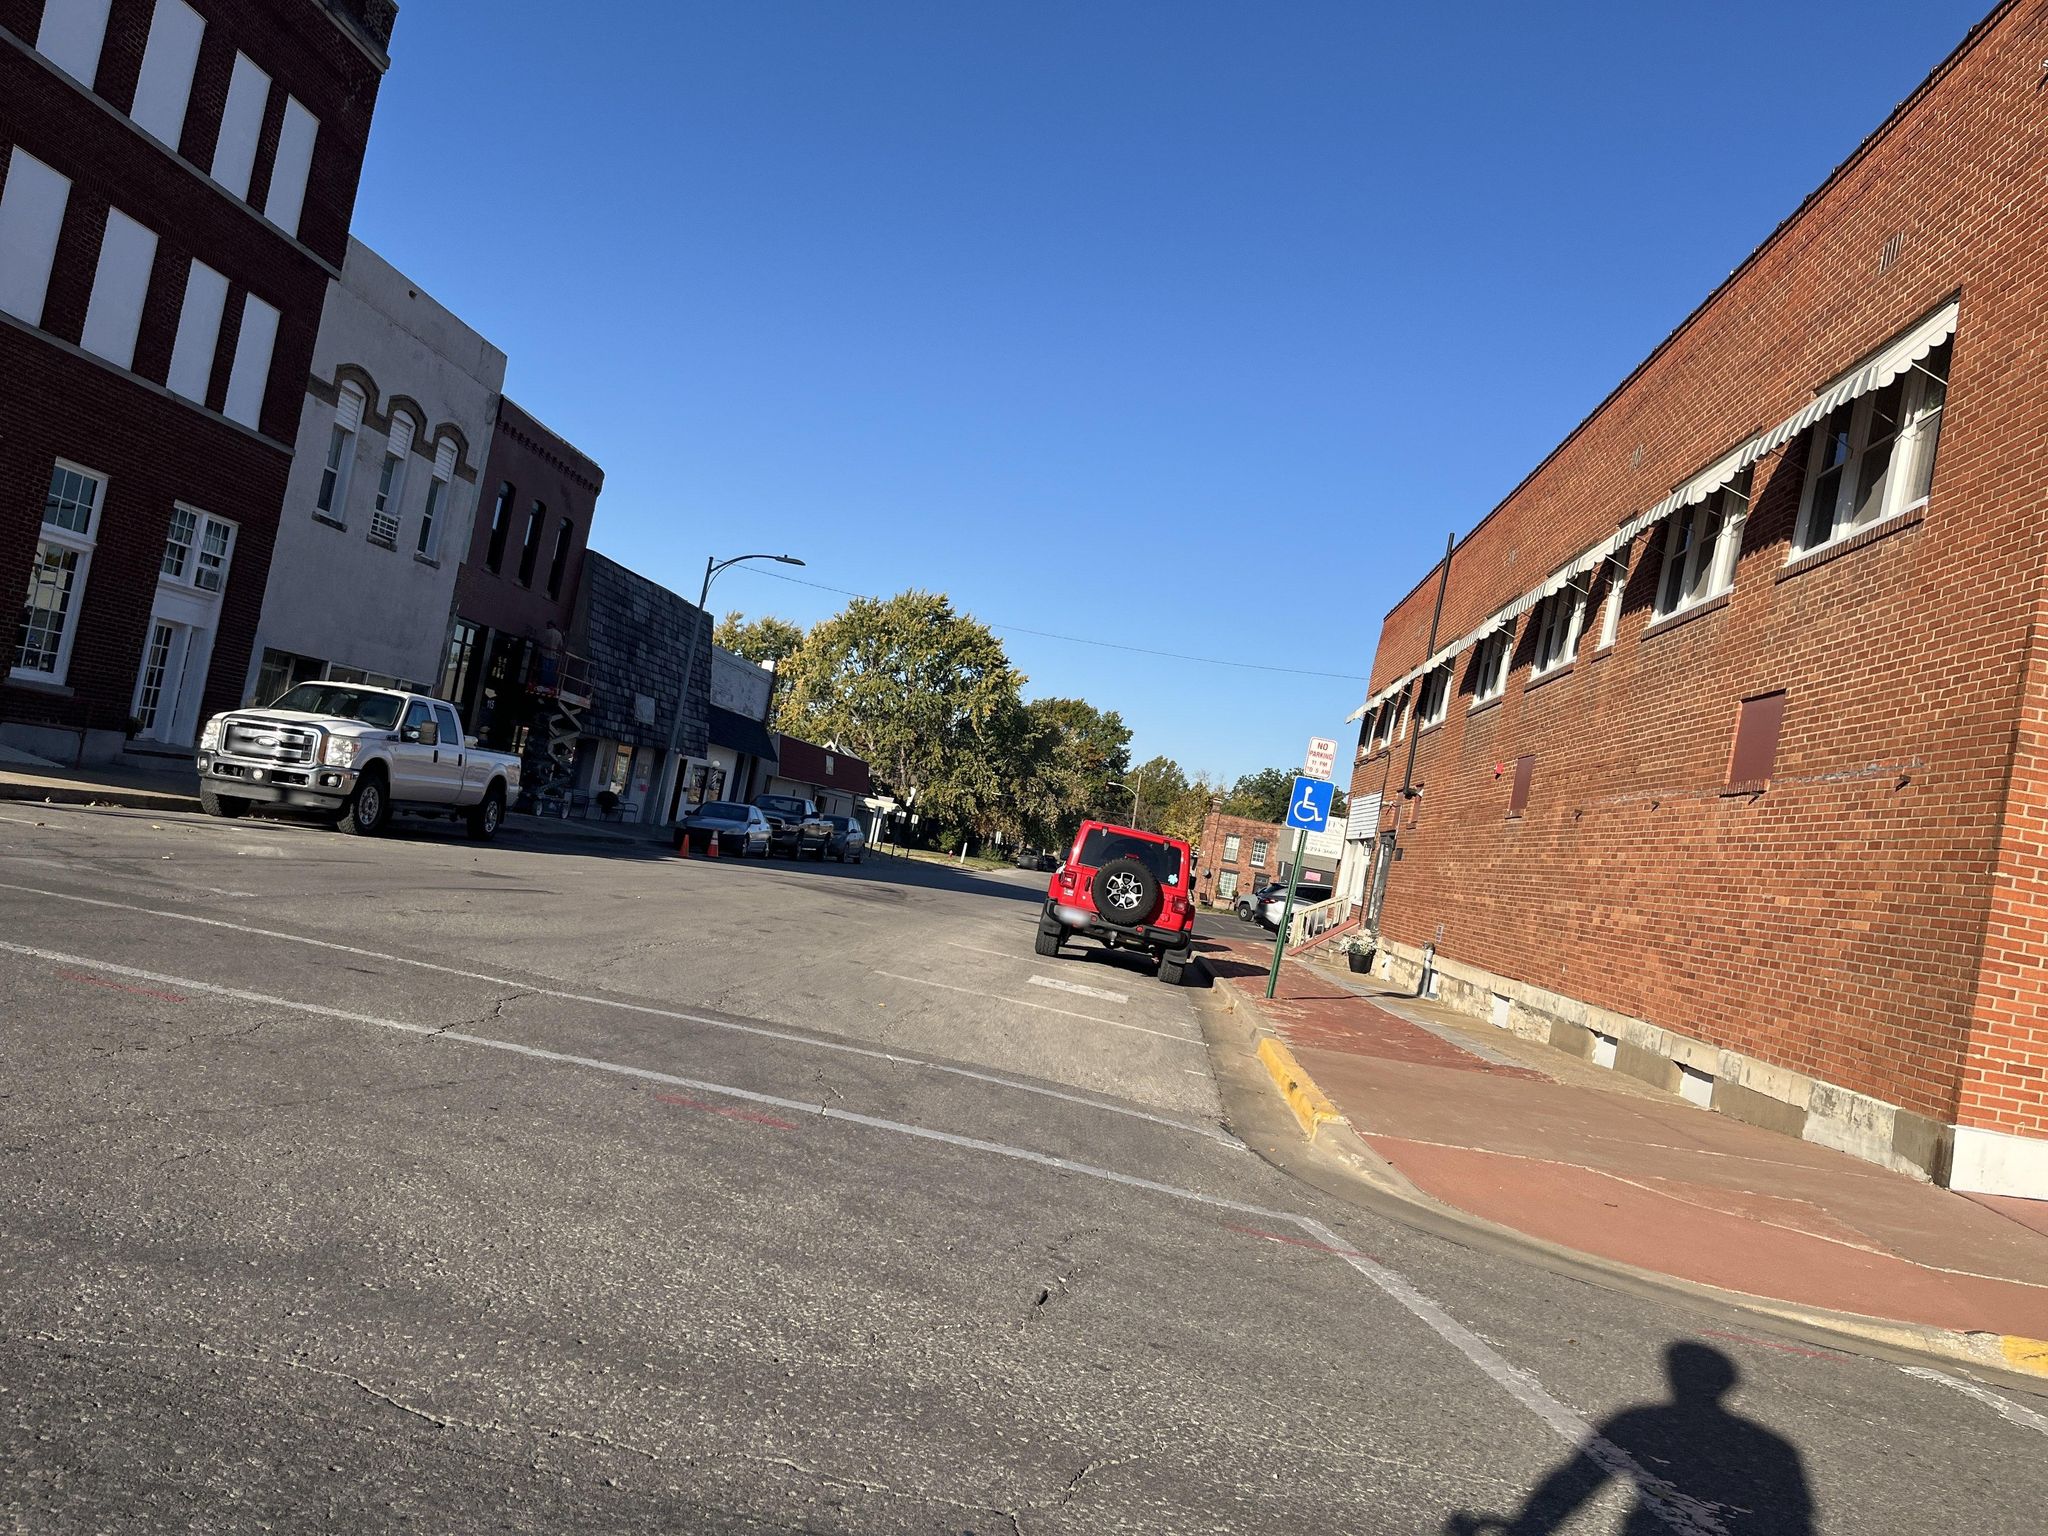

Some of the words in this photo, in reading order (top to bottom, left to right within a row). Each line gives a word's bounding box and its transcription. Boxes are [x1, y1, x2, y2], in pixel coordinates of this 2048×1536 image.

[487, 697, 495, 709] 115
[1317, 742, 1329, 750] NO
[1309, 750, 1334, 760] PARKING
